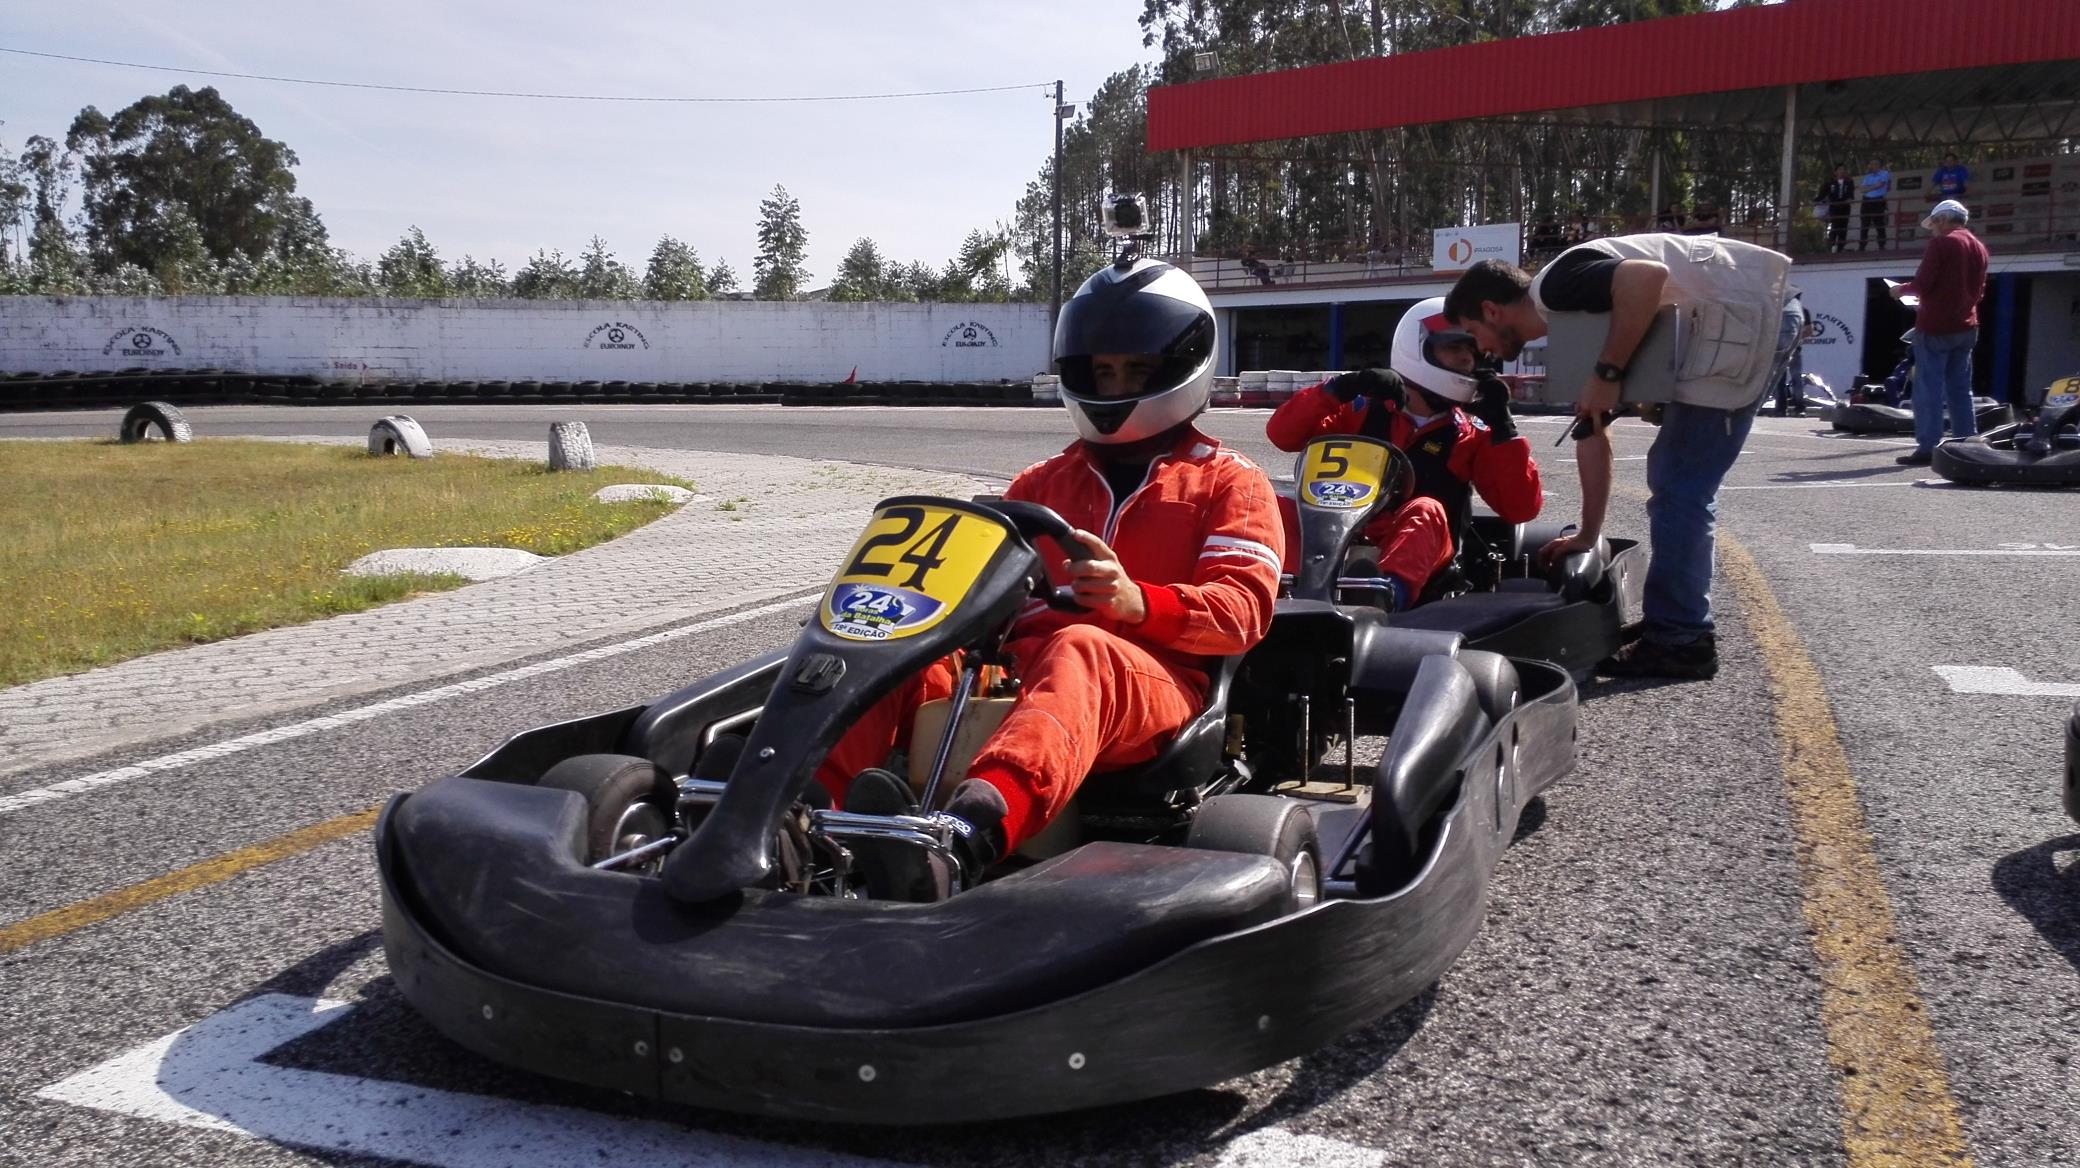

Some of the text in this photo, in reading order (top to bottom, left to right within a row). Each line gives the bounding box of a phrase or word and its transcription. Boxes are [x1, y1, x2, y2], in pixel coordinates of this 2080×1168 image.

[102, 326, 181, 356] ESCOLA KARTING
[583, 322, 650, 350] ESCOLA KARTING
[942, 321, 998, 347] ESCOLA KARTING
[1816, 313, 1854, 345] KARTING
[1317, 443, 1352, 478] 5
[1323, 484, 1347, 495] 24
[844, 507, 962, 592] 24
[847, 591, 893, 613] 24
[853, 612, 892, 625] Batalha
[847, 627, 886, 638] EDIÇÃO
